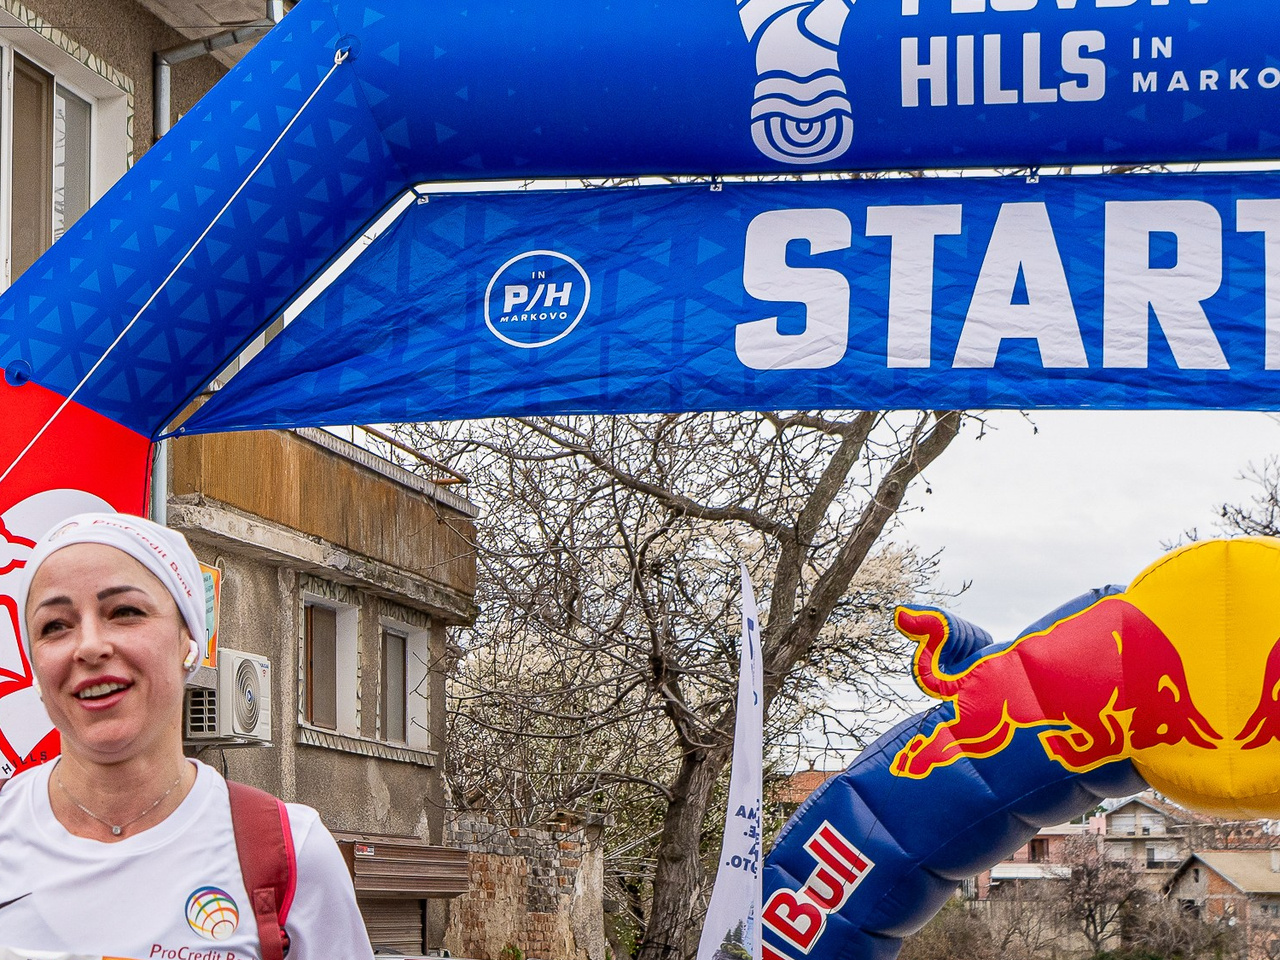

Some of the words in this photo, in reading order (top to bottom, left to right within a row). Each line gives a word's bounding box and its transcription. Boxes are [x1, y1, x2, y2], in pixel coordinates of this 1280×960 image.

[1132, 37, 1172, 59] IN
[901, 30, 1106, 107] HILLS
[532, 271, 545, 279] IN
[503, 282, 572, 313] P/H
[500, 311, 568, 323] MARKOVO
[1, 750, 47, 775] HILLS
[761, 825, 869, 950] Bull
